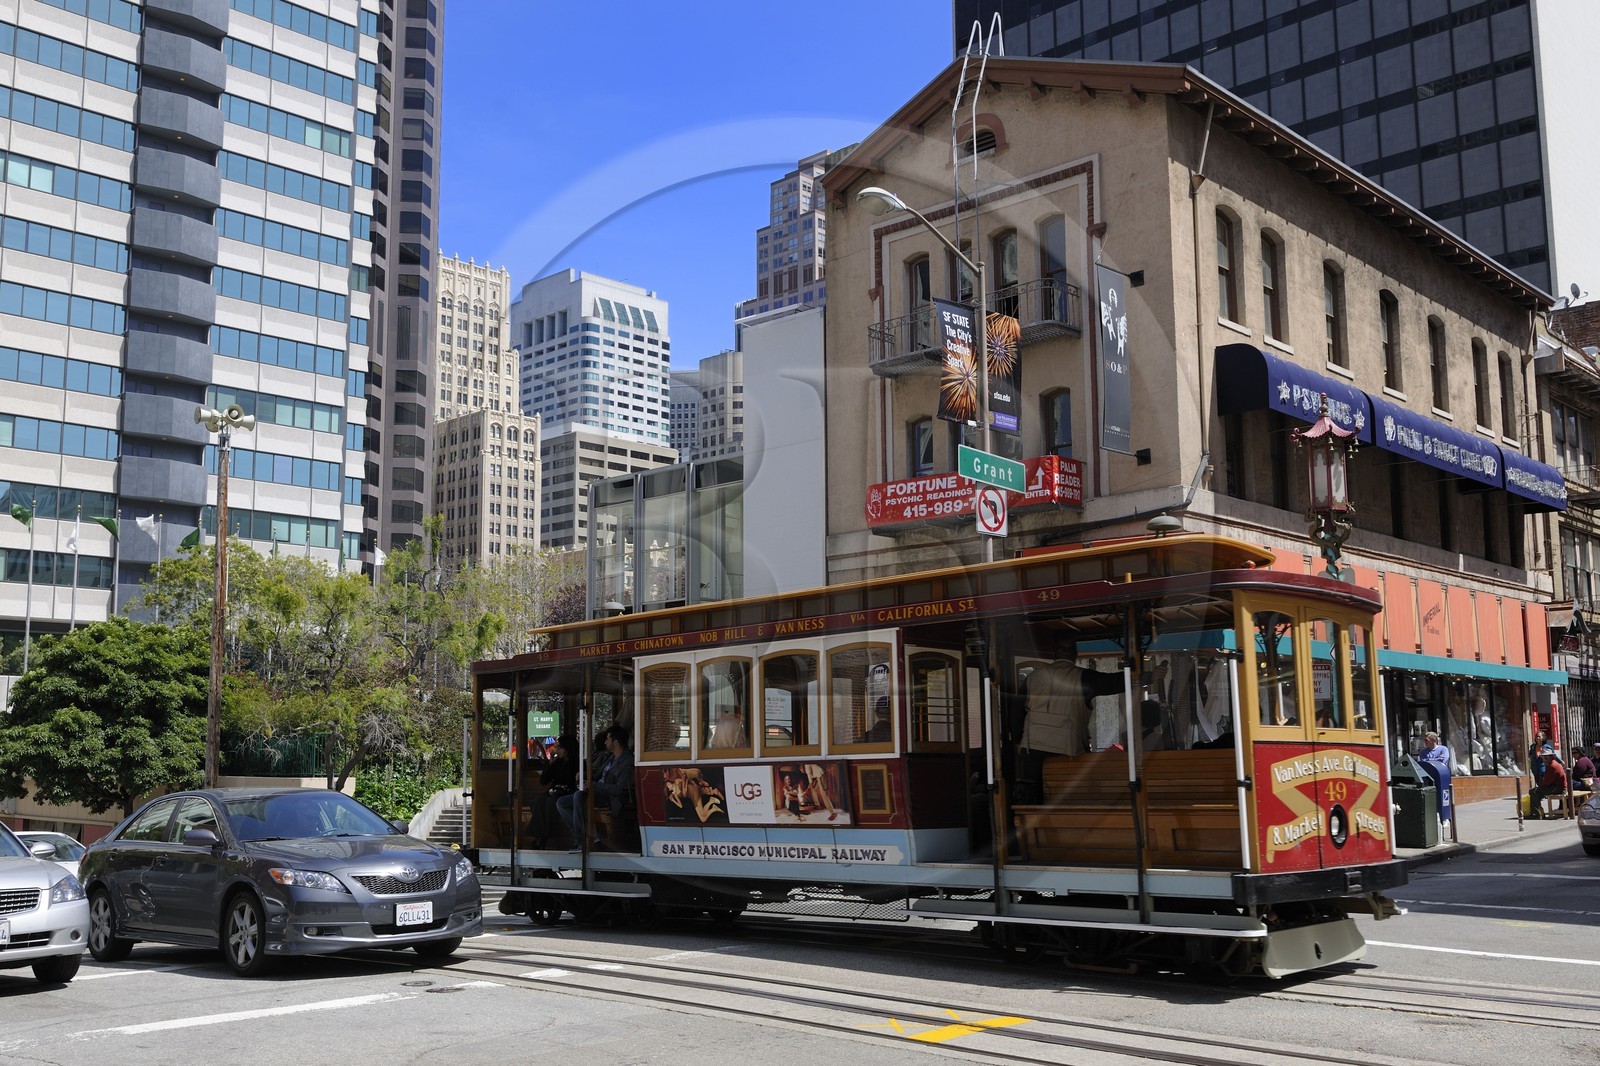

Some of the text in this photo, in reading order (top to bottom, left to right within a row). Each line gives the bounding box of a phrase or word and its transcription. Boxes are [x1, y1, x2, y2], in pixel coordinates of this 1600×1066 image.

[943, 311, 970, 328] SF STATE
[945, 325, 972, 343] The City's
[947, 339, 970, 356] Creative
[947, 354, 965, 370] Spark
[973, 457, 1013, 482] Grant
[1060, 461, 1077, 474] PALM
[887, 476, 957, 496] FORTUNE
[1054, 473, 1081, 488] READER
[885, 487, 973, 506] PSYCHIC READINGS
[1025, 489, 1051, 499] ENTER
[1038, 589, 1061, 601] 49
[580, 644, 611, 657] MARKET
[634, 636, 684, 651] CHINATOWN
[700, 631, 718, 643] NOB
[724, 628, 747, 639] HILL
[775, 621, 795, 634] VAN
[797, 618, 825, 631] NESS
[878, 603, 954, 622] CALIFORNIA
[1273, 765, 1295, 784] Van
[1294, 758, 1321, 780] Ness
[733, 782, 763, 801] UGG
[1324, 781, 1348, 801] 49
[1273, 811, 1385, 846] & Market Streets
[661, 843, 887, 861] SAN FRANCISCO MUNICIPAL RAILWAY
[398, 909, 431, 923] 6CLL431
